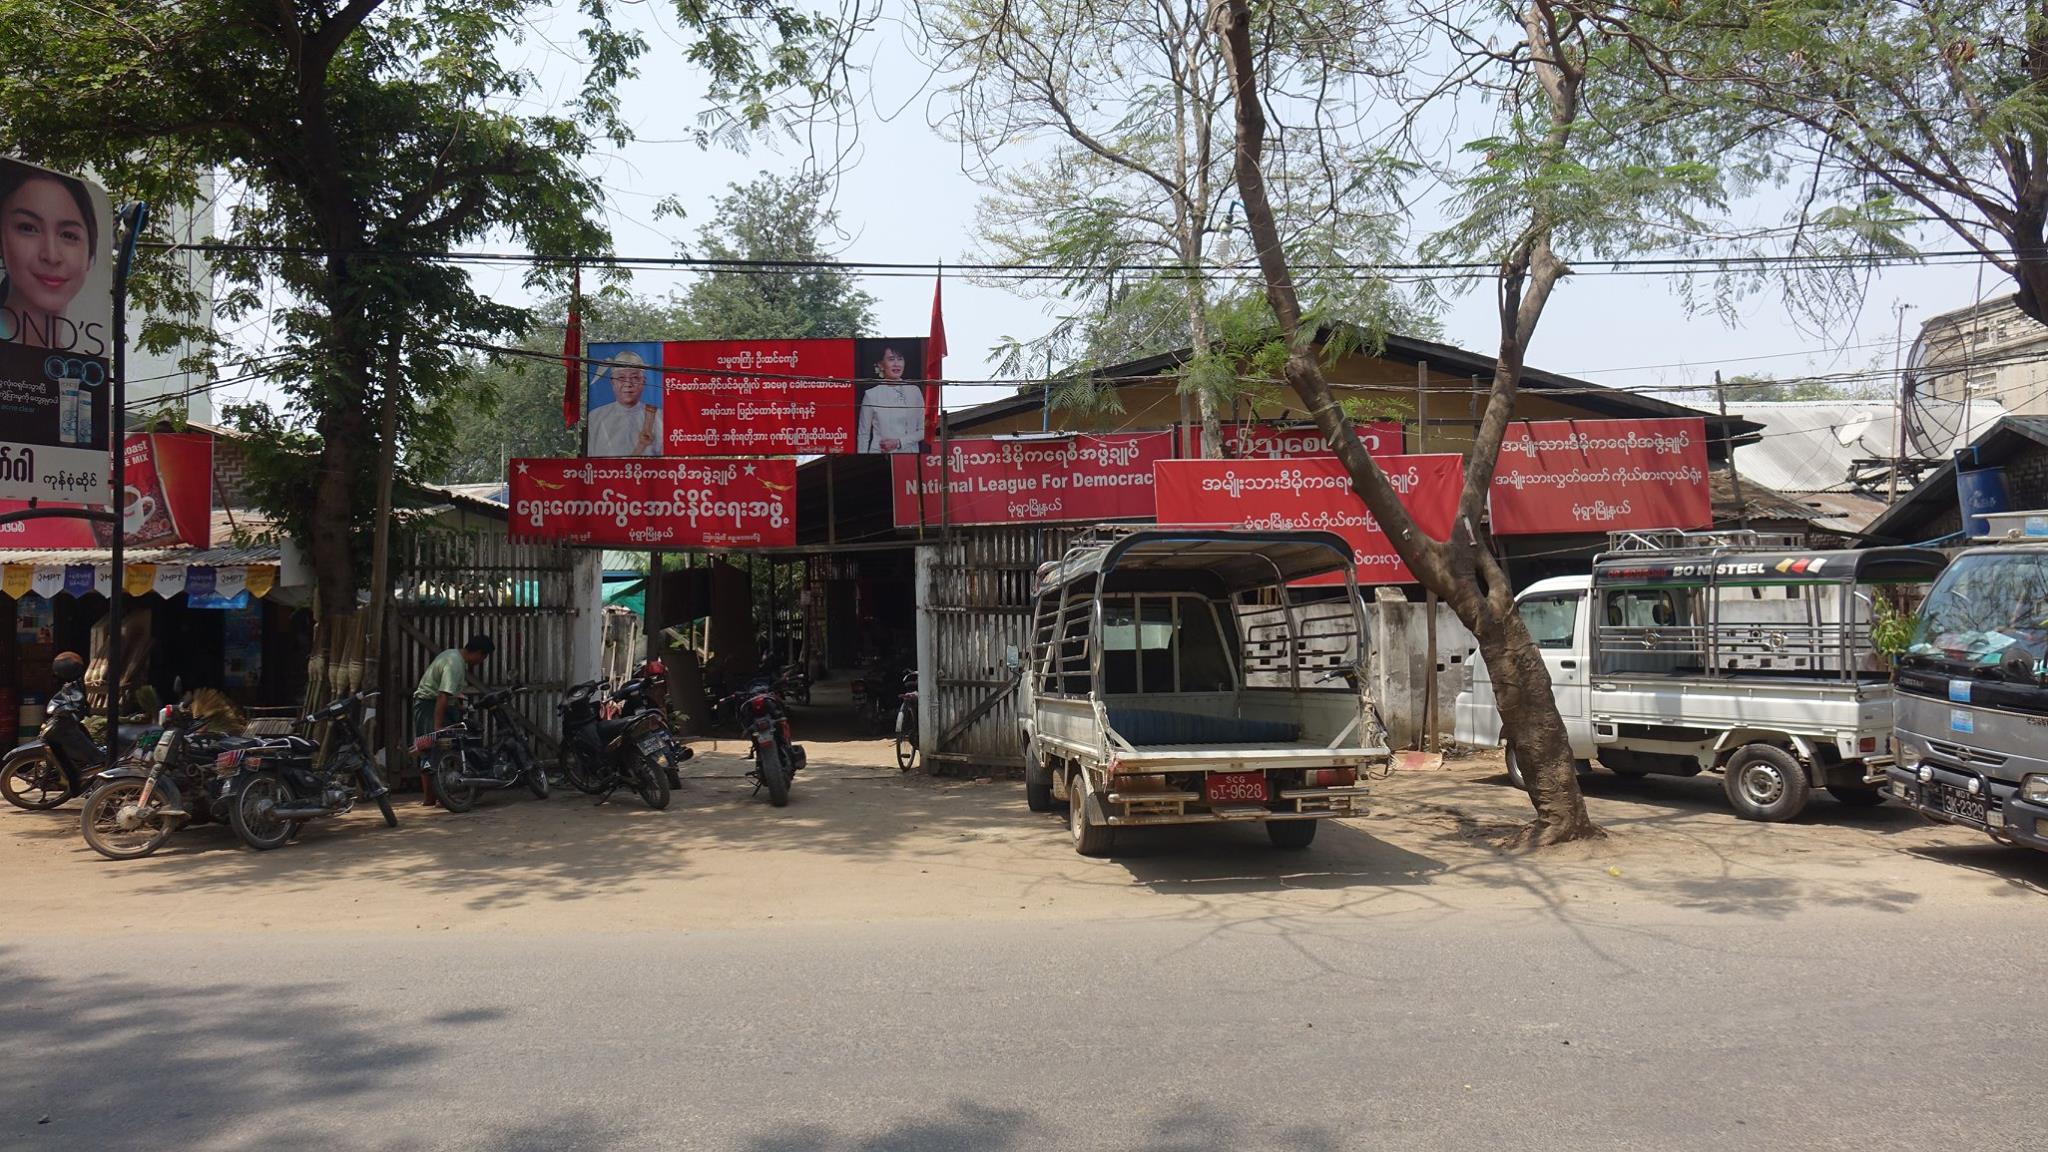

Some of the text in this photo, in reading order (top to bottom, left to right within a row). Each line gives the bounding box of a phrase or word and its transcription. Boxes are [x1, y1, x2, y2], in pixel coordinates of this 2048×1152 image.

[0, 306, 104, 357] OND'S
[906, 471, 1154, 495] Natinal League For Democrac
[1716, 563, 1766, 575] STEEL
[1945, 795, 1984, 820] 3K-2329
